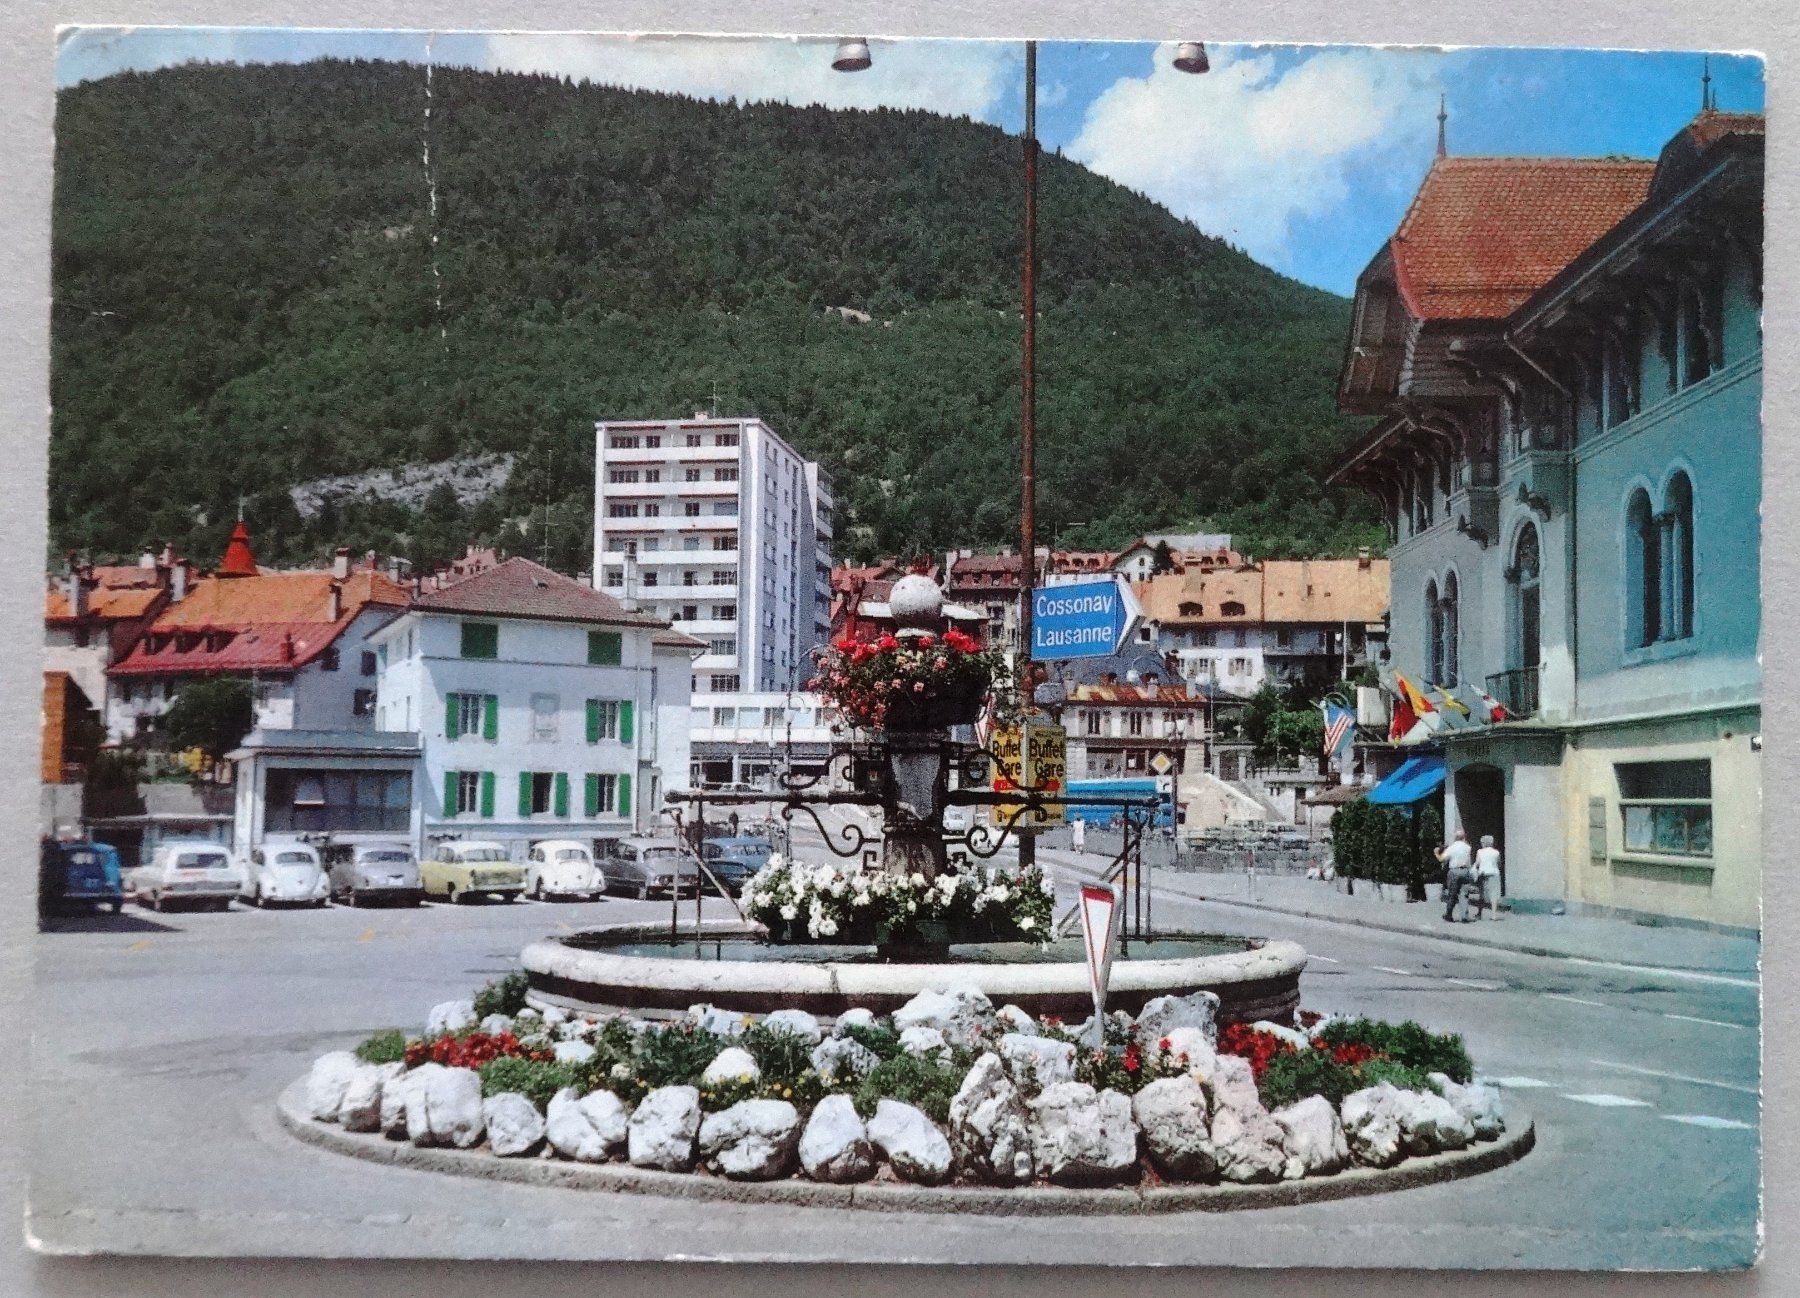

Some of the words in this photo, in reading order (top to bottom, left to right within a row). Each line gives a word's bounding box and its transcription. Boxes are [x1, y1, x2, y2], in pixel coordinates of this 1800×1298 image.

[1036, 595, 1112, 617] Cossonay
[1037, 626, 1112, 647] Lausanne
[993, 739, 1021, 758] Buffet
[1029, 738, 1065, 758] Buffet
[1035, 758, 1065, 778] Gare
